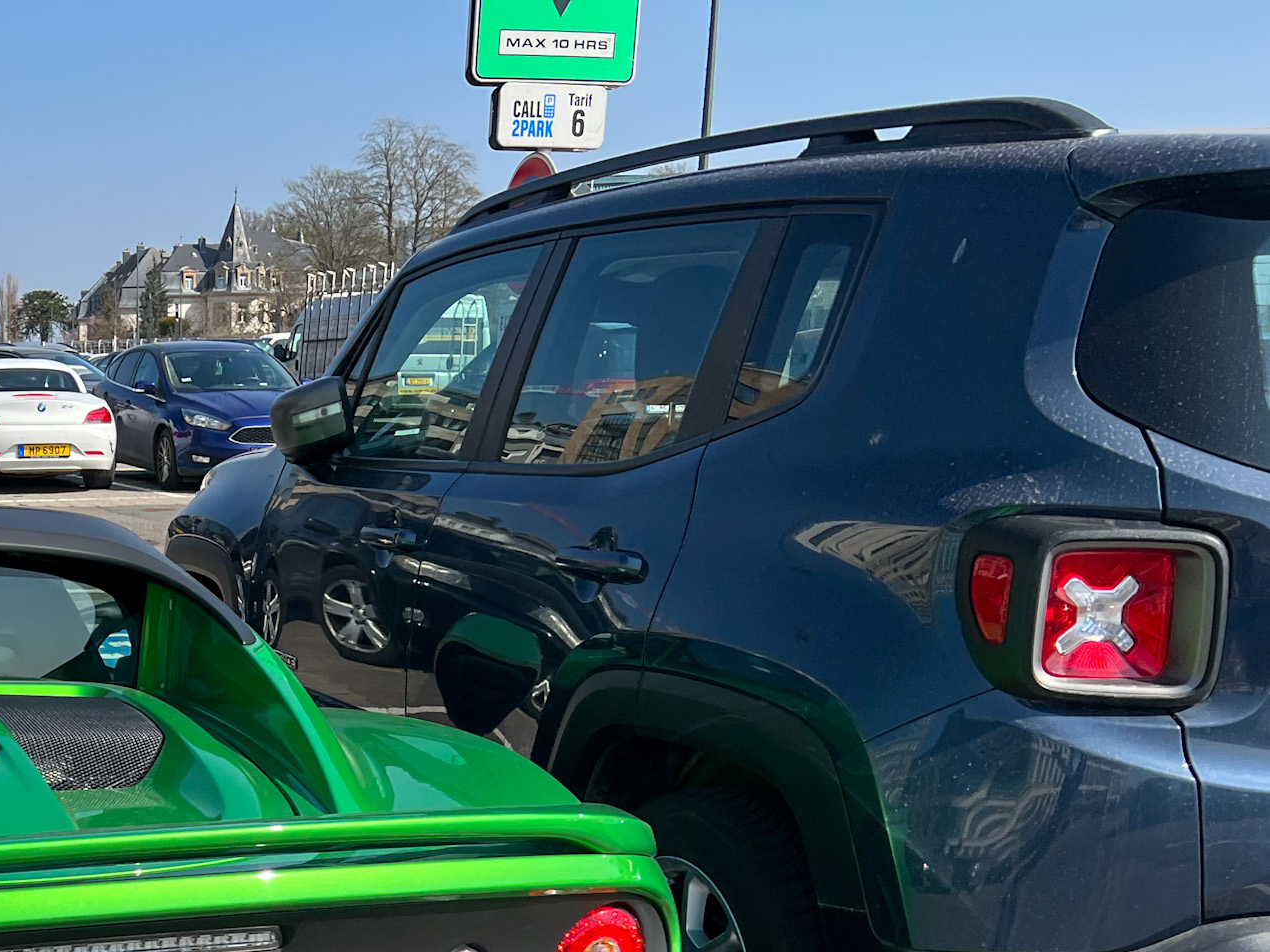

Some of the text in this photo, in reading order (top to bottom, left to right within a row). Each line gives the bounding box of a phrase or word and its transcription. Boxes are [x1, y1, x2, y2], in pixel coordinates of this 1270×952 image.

[506, 38, 608, 50] MAX 10 HRS
[569, 93, 593, 107] Tarif
[513, 100, 542, 118] CALL
[511, 119, 553, 138] 2PARK
[571, 109, 585, 138] 6
[42, 446, 67, 455] 6907
